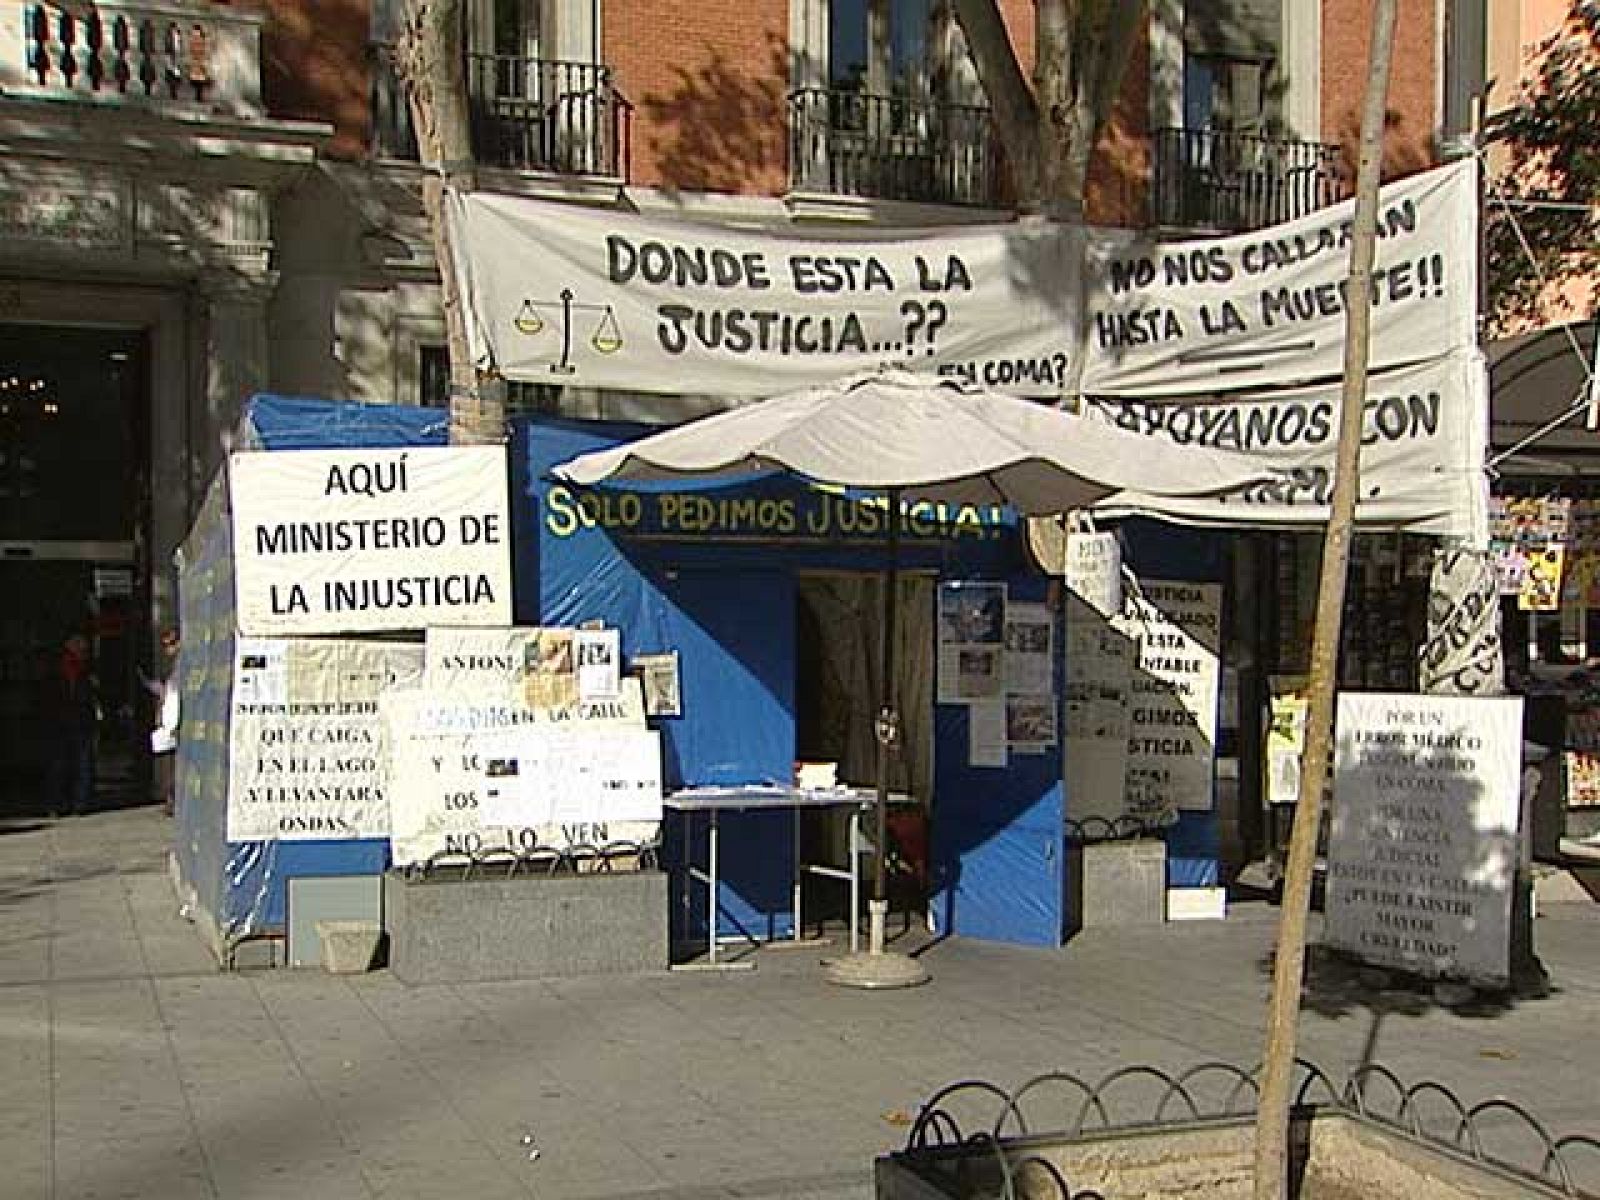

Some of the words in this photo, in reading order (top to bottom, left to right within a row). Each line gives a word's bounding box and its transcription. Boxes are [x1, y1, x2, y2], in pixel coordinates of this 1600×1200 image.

[605, 234, 771, 289] DONDE
[788, 255, 894, 292] ESTA
[916, 255, 973, 292] LA
[1111, 258, 1155, 294] NO
[1164, 248, 1234, 288] NOS
[1096, 309, 1184, 350] HASTA
[1200, 299, 1247, 336] LA
[1260, 252, 1444, 328] MUETE!!
[984, 353, 1067, 388] COMA?
[1360, 392, 1441, 447] CON
[324, 452, 409, 498] AQUÍ
[546, 485, 642, 538] SOLO
[660, 495, 797, 534] PEDIMOS
[256, 515, 446, 556] MINISTERIO
[459, 514, 501, 546] DE
[269, 583, 310, 615] LA
[324, 574, 495, 612] INJUSTICIA
[308, 729, 373, 743] CAIGA
[1133, 707, 1198, 725] GIMOS
[1126, 737, 1195, 756] STICIA
[444, 792, 479, 811] LOS
[279, 816, 349, 830] ONDAS
[445, 831, 481, 853] NO
[506, 827, 538, 852] LO
[561, 821, 609, 846] VEN
